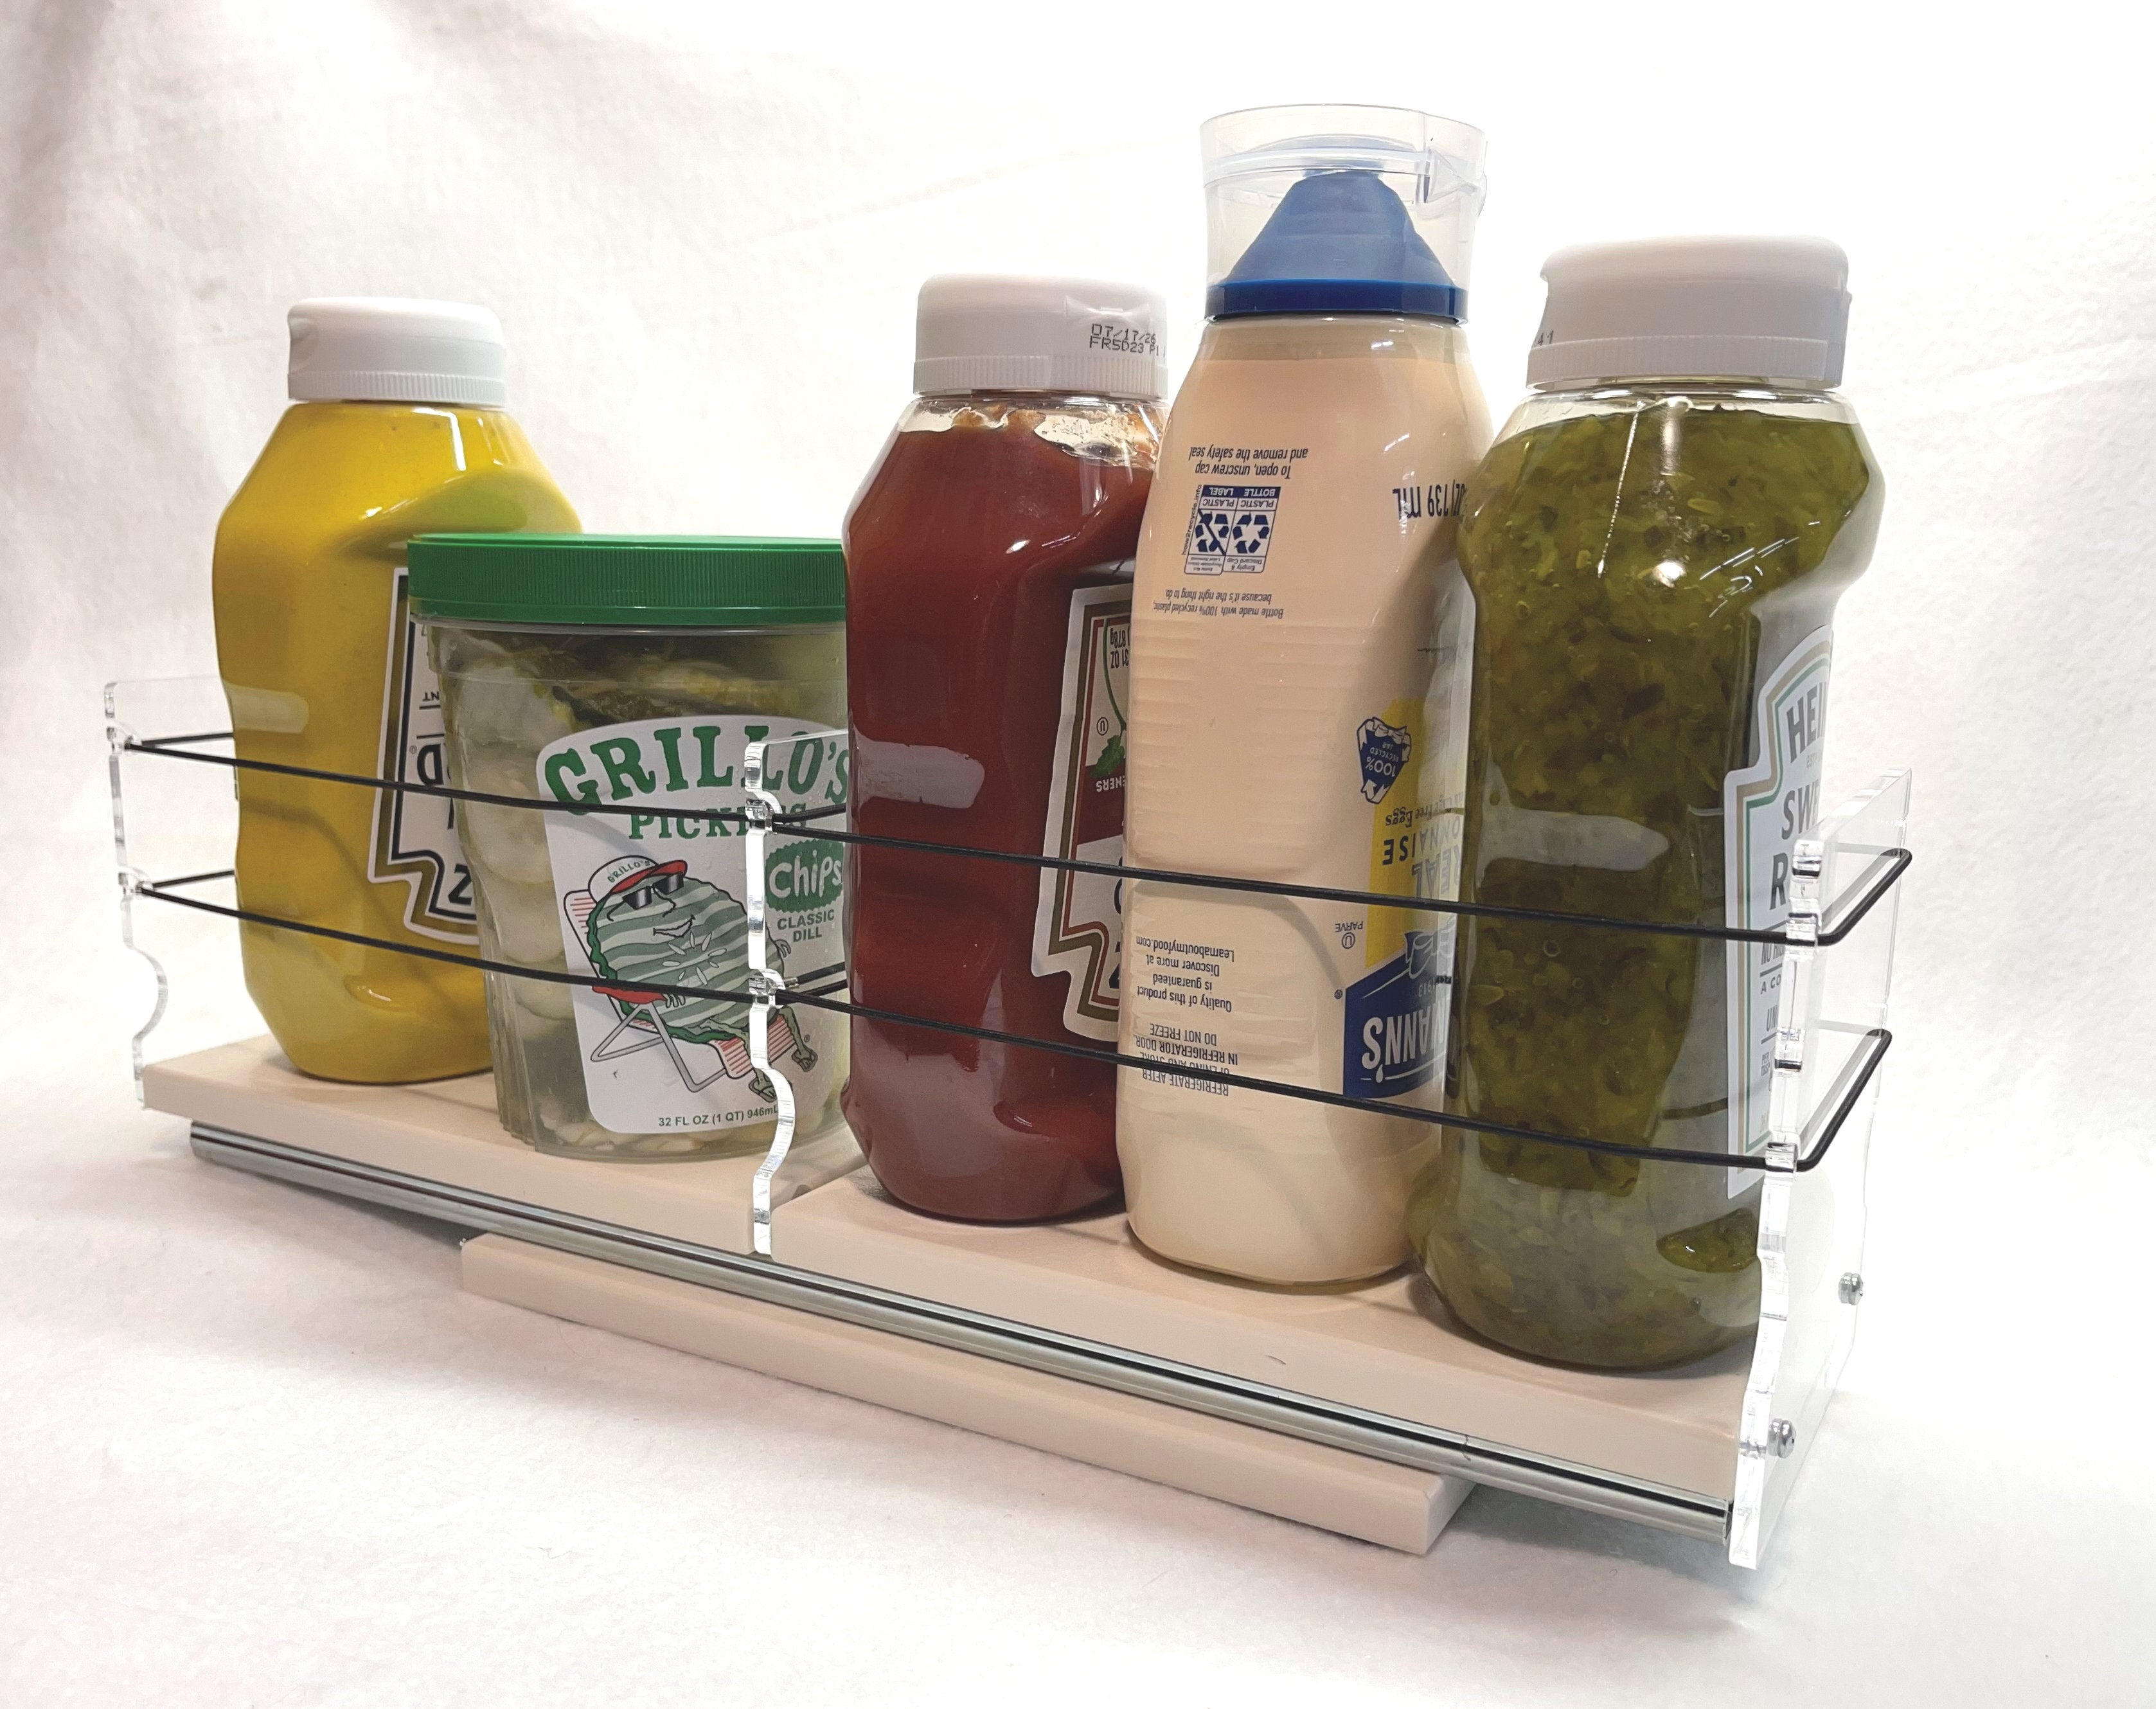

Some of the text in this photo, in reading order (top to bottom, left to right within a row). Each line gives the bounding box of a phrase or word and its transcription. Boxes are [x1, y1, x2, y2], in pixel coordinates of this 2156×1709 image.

[1092, 323, 1156, 345] 07/17/26
[1188, 444, 1308, 463] and remove the safety seal
[1195, 460, 1291, 479] To open, unscrew cap
[1209, 487, 1234, 496] LABEL
[1243, 488, 1276, 497] BOTTLE
[1202, 498, 1235, 508] PLASTIC
[1240, 499, 1274, 508] PLASTIC
[1173, 589, 1179, 598] to
[1180, 587, 1197, 602] thing
[1198, 589, 1215, 603] right
[1215, 592, 1227, 602] the
[1241, 593, 1272, 605] because
[1172, 602, 1197, 614] recycled
[1198, 606, 1218, 616] 100%
[1221, 607, 1237, 617] with
[1239, 607, 1259, 618] made
[1261, 608, 1284, 620] Bottle
[1110, 627, 1127, 649] 878g
[1110, 649, 1129, 669] 31 OZ
[1365, 756, 1396, 777] 100%
[1385, 806, 1413, 828] Eggs
[769, 849, 842, 899] Chips
[777, 909, 835, 930] CLASSIC
[1335, 920, 1364, 933] PARVE
[792, 927, 823, 943] DILL
[1146, 954, 1220, 977] Discover more at
[1152, 973, 1213, 994] is guaranteed
[1137, 985, 1232, 1013] Quality of this product
[1149, 1023, 1217, 1046] DO NOT FREEZE
[1159, 1040, 1225, 1064] REFRIGERATOR
[1228, 1052, 1238, 1066] IN
[658, 1117, 672, 1127] 32
[675, 1116, 690, 1126] FL
[692, 1114, 709, 1125] OZ
[712, 1113, 721, 1125] (1
[726, 1111, 744, 1122] QT)
